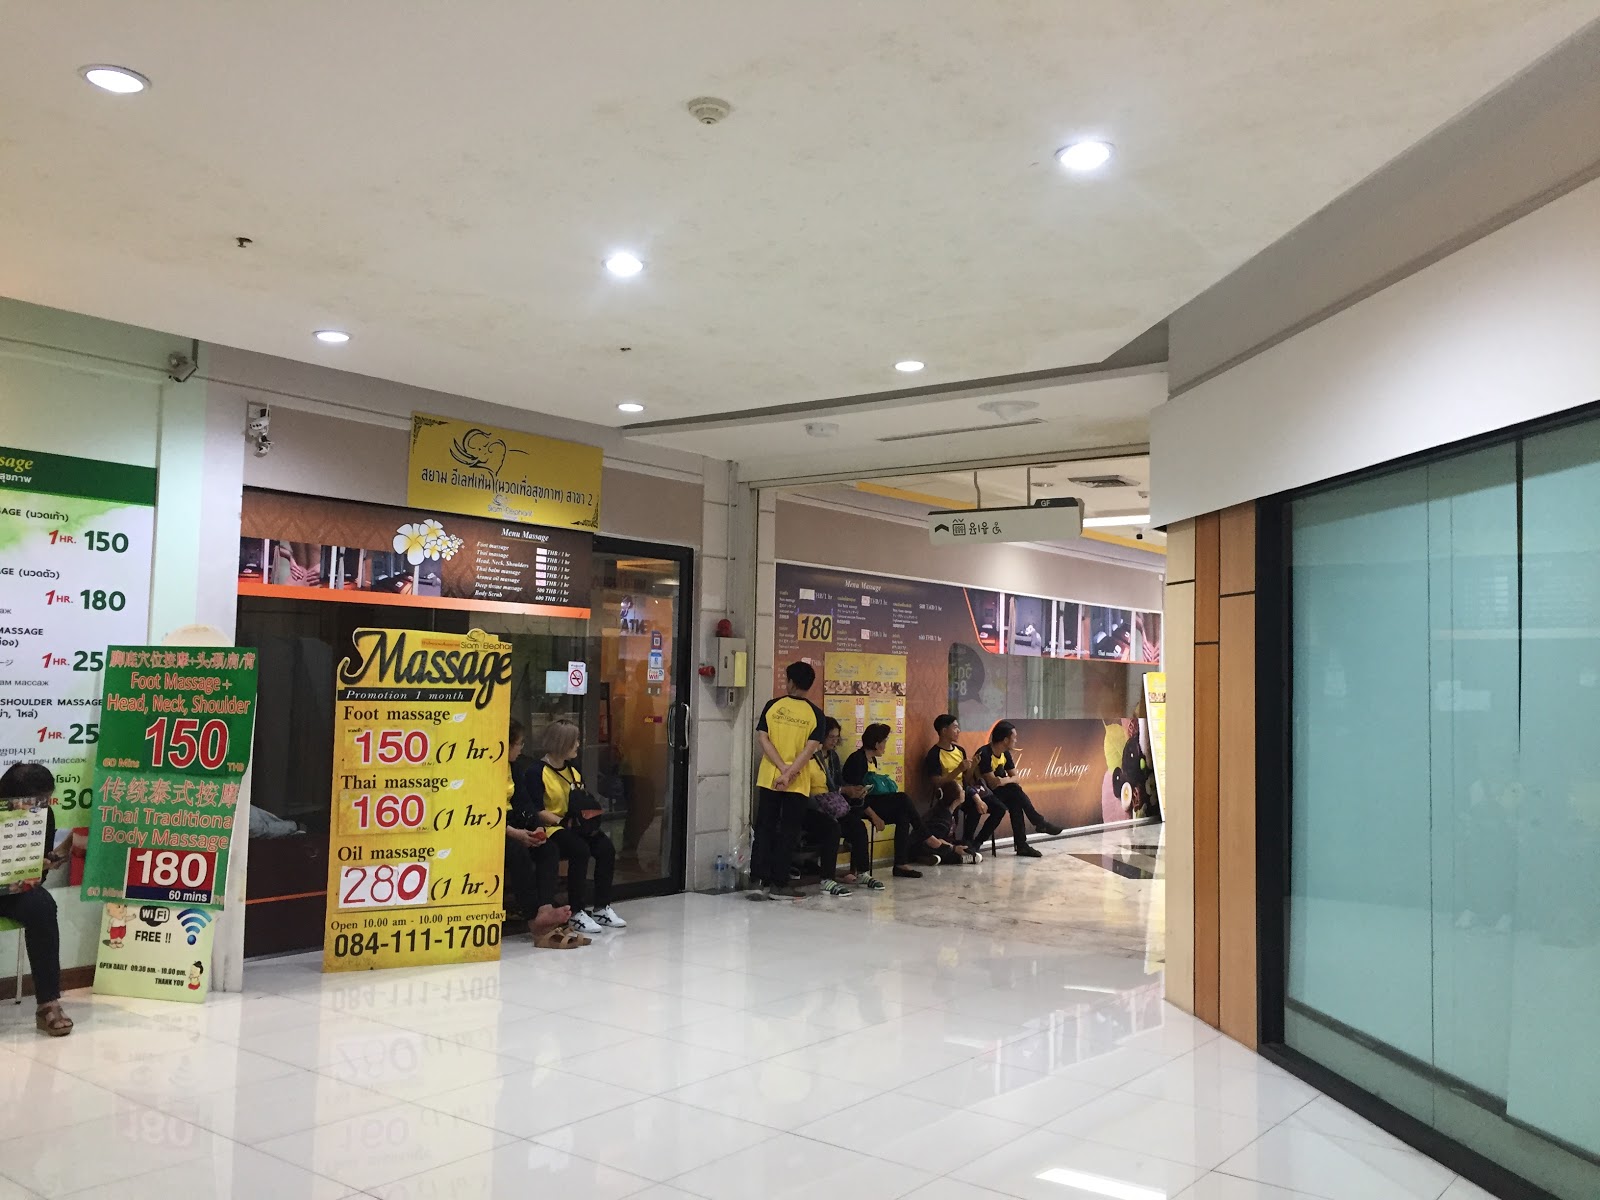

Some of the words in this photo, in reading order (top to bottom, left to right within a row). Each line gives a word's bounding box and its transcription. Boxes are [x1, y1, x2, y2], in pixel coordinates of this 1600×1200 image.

[0, 457, 34, 473] sage
[421, 468, 448, 484] สยาม
[567, 491, 585, 505] สาขา
[588, 494, 593, 506] 2
[0, 508, 22, 517] AGE
[49, 530, 59, 545] 1
[60, 536, 77, 544] HR.
[84, 530, 129, 553] 150
[501, 528, 520, 538] Menu
[522, 531, 550, 542] Massage
[0, 568, 14, 576] GE
[45, 590, 56, 605] 1
[80, 589, 126, 612] 180
[801, 615, 832, 641] 180
[461, 641, 480, 650] Siam
[42, 652, 53, 669] 1
[53, 658, 70, 666] HR.
[73, 650, 104, 672] 25
[340, 629, 512, 711] Massage
[131, 672, 161, 690] Foot
[0, 699, 53, 707] SHOULDER
[57, 699, 103, 707] MASSAGE
[107, 694, 148, 715] Head,
[152, 695, 189, 716] Neck,
[191, 695, 251, 715] Shoulder
[346, 690, 408, 702] Promotion
[415, 691, 421, 700] 1
[429, 691, 464, 701] month
[344, 705, 379, 720] Foot
[386, 707, 451, 725] massage
[38, 726, 48, 743] 1
[48, 731, 66, 740] HR.
[68, 723, 100, 745] 25
[145, 717, 230, 770] 150
[354, 730, 429, 764] 150
[436, 741, 457, 764] (1
[466, 738, 505, 765] hr.)
[103, 758, 117, 769] 60
[118, 758, 140, 769] Mins
[227, 762, 245, 773] THB
[1038, 746, 1091, 791] Massage
[56, 774, 81, 784] โรม่า)
[341, 774, 376, 790] Thai
[384, 777, 448, 794] massage
[62, 788, 93, 810] 30
[99, 776, 240, 808] 传统泰式按摩
[97, 806, 139, 823] Thai
[142, 808, 233, 831] Traditiona
[354, 795, 425, 829] 160
[434, 809, 455, 831] (1
[463, 805, 503, 830] hr.)
[101, 826, 148, 849] Body
[151, 829, 228, 852] Massage
[338, 846, 363, 862] Oil
[371, 848, 434, 863] massage
[136, 850, 208, 888] 180
[343, 864, 428, 904] 280
[431, 877, 451, 901] (1
[461, 872, 500, 899] hr.)
[168, 889, 181, 901] 60
[183, 892, 207, 902] mins
[331, 921, 358, 933] Open
[363, 917, 388, 928] 10.00
[392, 918, 407, 926] am
[420, 914, 443, 925] 10.00
[447, 915, 462, 927] pm
[465, 911, 505, 925] everyday
[135, 930, 162, 943] FREE
[335, 923, 501, 958] 084-111-1700
[155, 978, 172, 986] THANK
